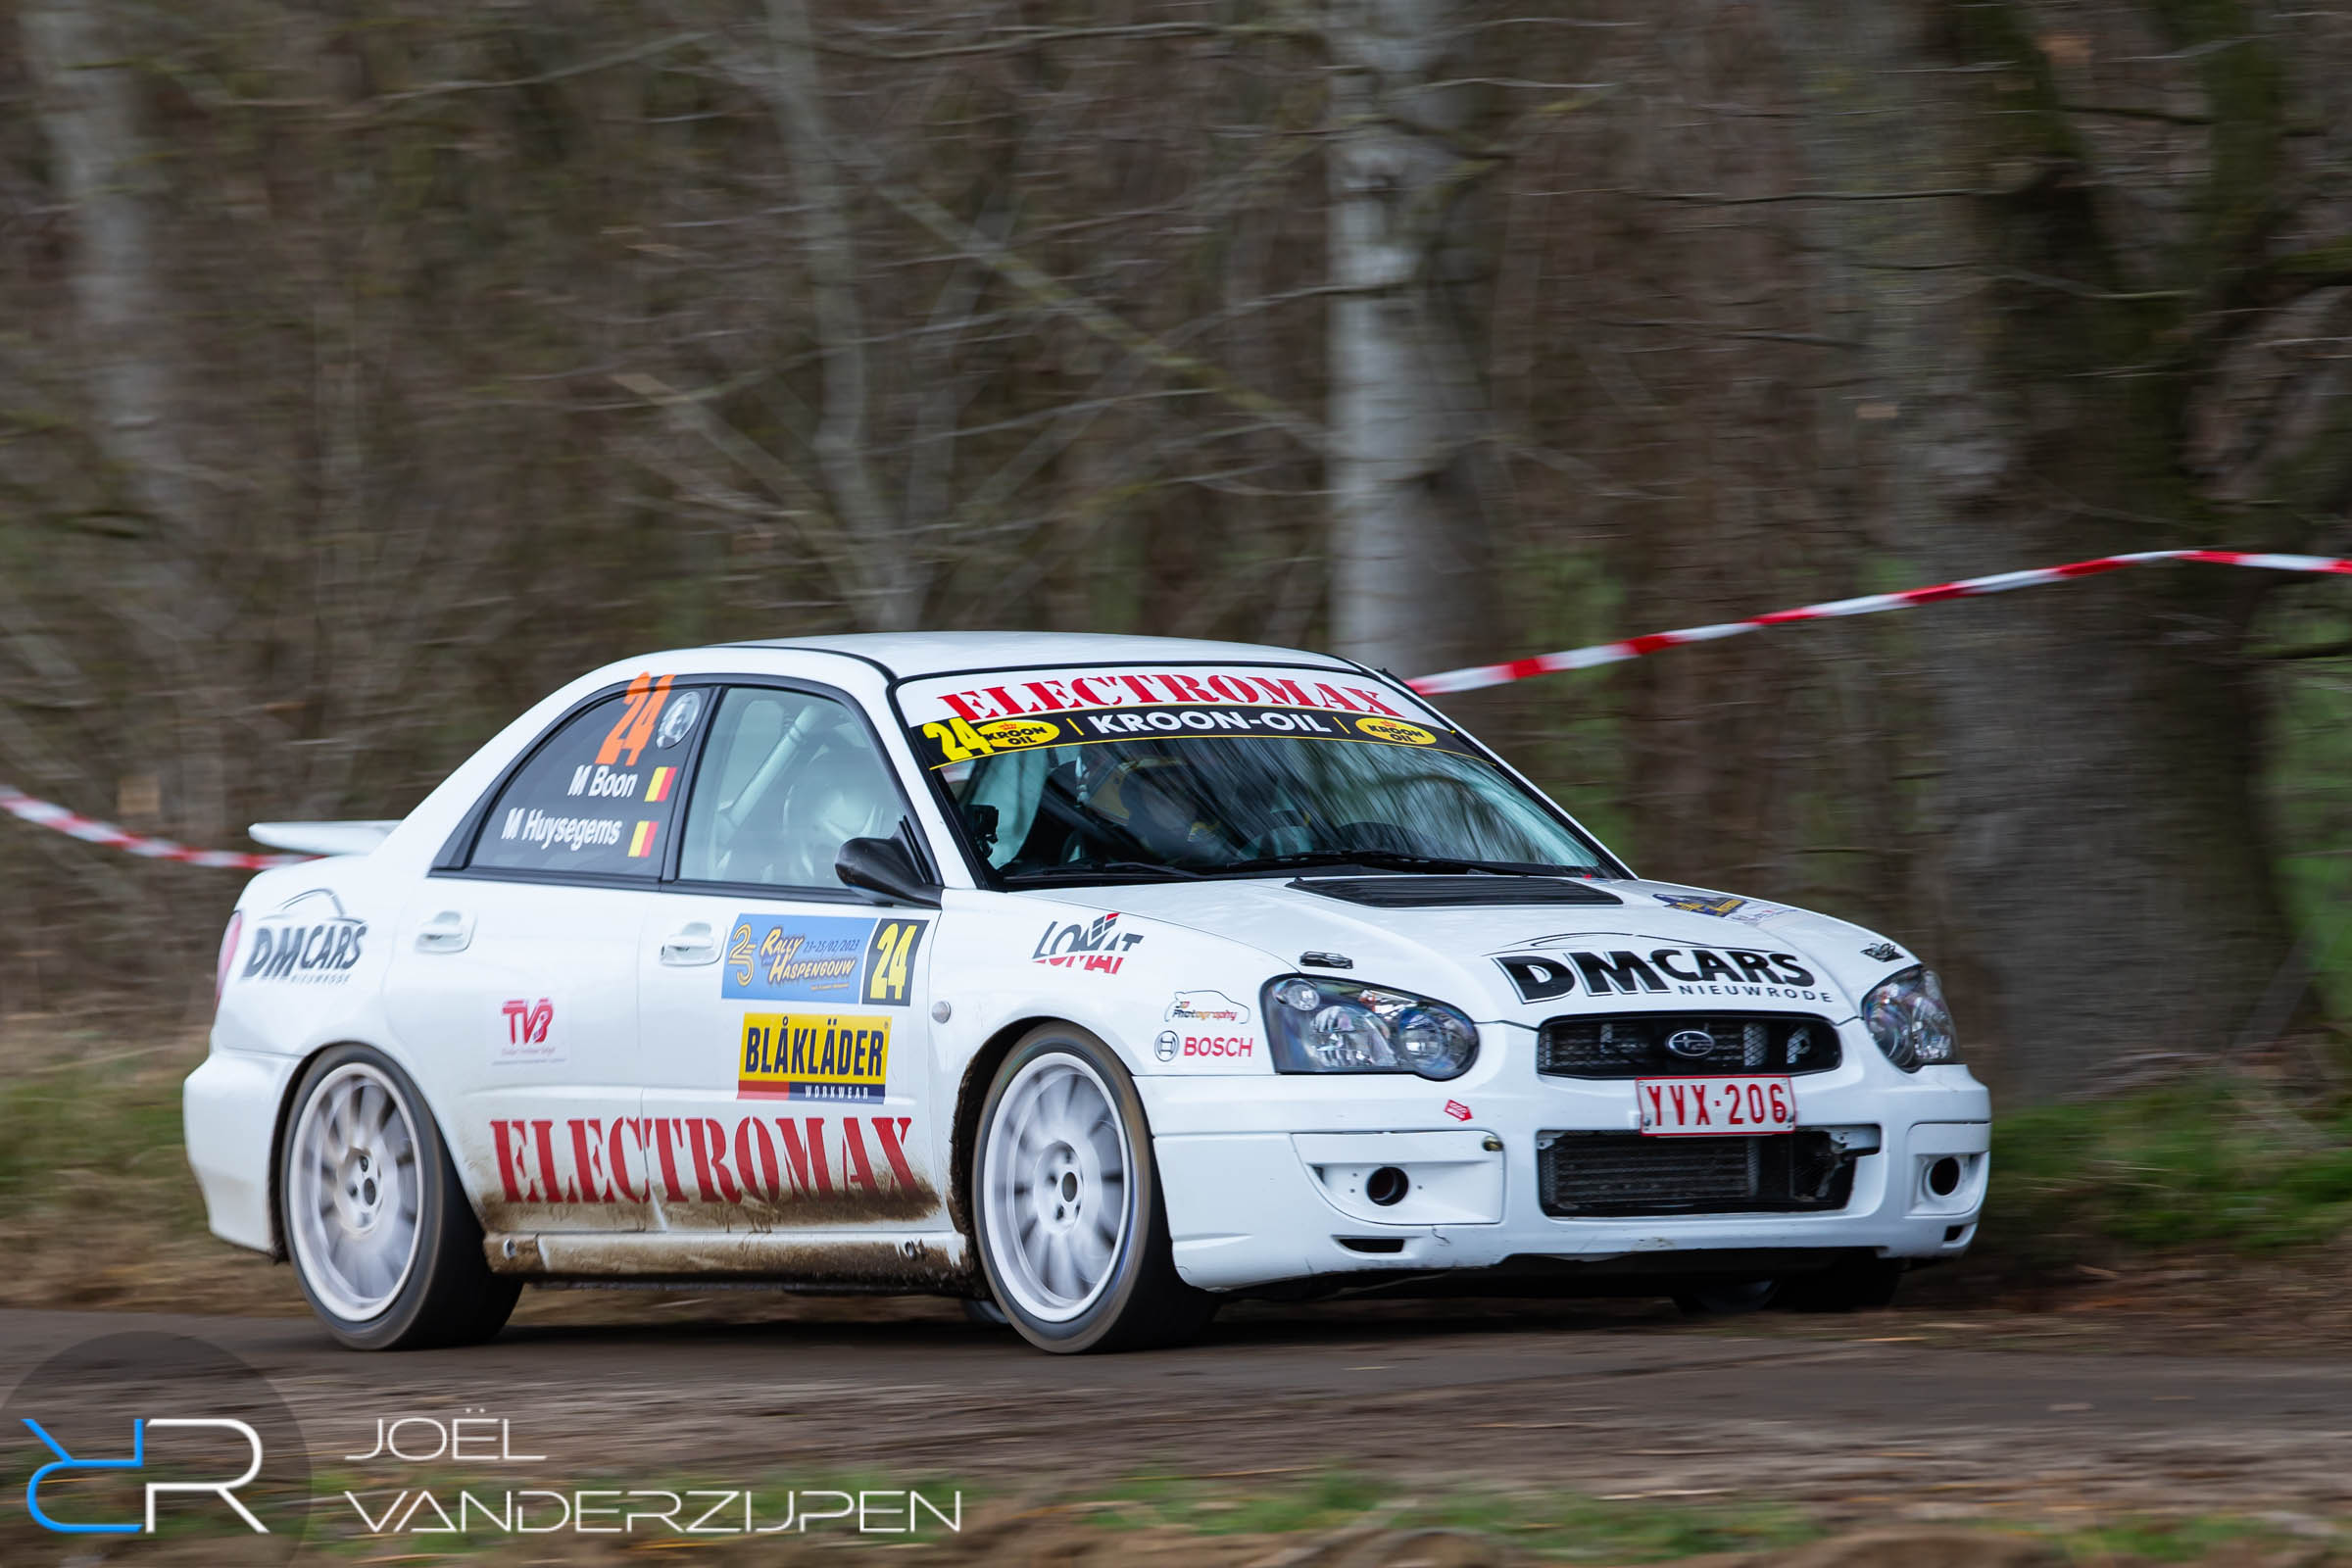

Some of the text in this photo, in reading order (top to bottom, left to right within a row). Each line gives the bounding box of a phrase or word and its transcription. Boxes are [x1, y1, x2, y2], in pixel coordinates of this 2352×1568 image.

[936, 673, 1407, 722] ELECTROMAX
[594, 670, 676, 766] 24
[1085, 710, 1333, 735] KROON-OIL
[1366, 724, 1426, 738] KROON
[921, 716, 995, 761] 24
[983, 725, 1048, 741] KROON
[1007, 737, 1037, 746] OIL
[1390, 733, 1417, 743] OIL
[567, 764, 639, 798] M Boon
[501, 807, 624, 852] M Huysegems
[869, 922, 918, 1001] 24
[1678, 984, 1834, 1004] NIEUWRODE
[745, 1016, 885, 1077] BLÅKLÄDER
[1184, 1037, 1254, 1057] BOSCH
[805, 1084, 869, 1100] WORKWEAR
[490, 1116, 926, 1204] ELECTROMAX
